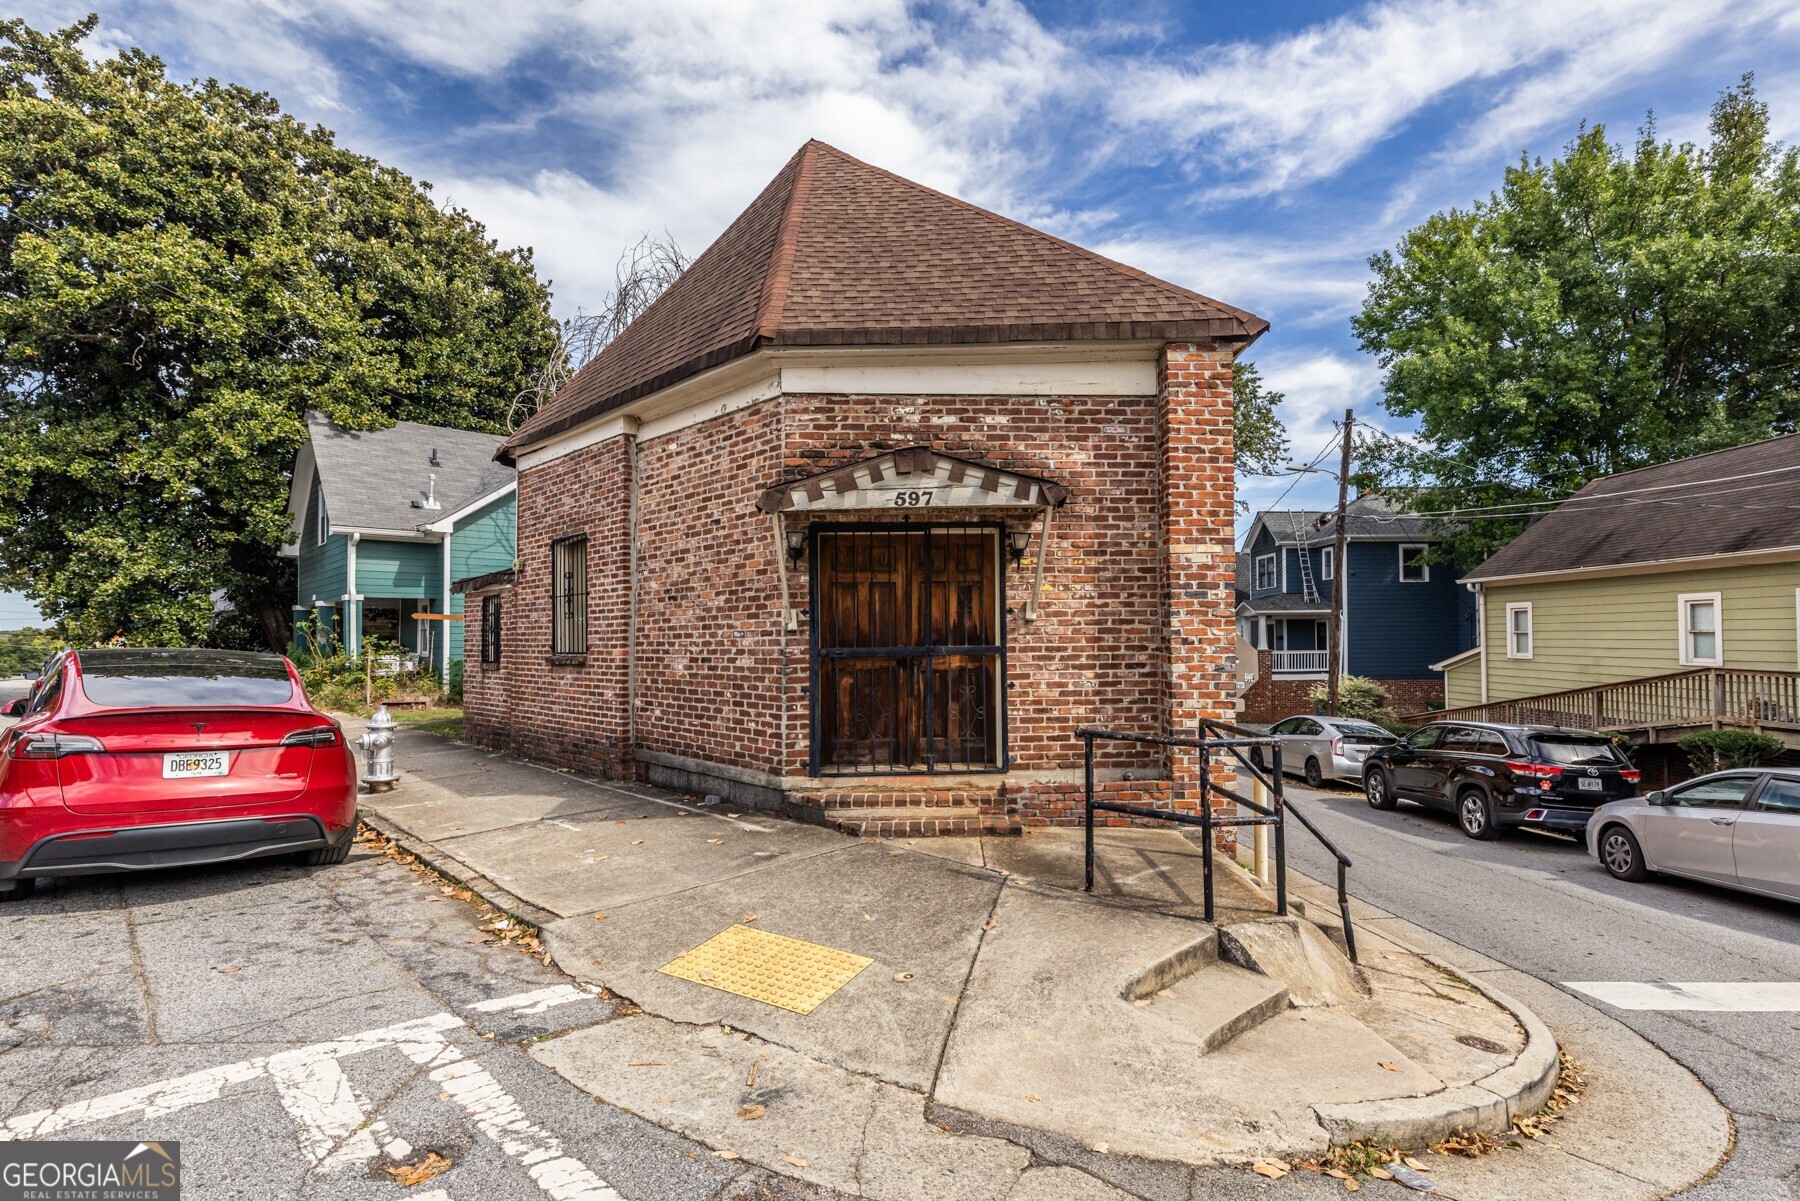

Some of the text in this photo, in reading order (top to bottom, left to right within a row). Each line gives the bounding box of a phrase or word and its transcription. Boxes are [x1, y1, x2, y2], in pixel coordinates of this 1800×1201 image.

[895, 491, 933, 506] 597
[178, 752, 214, 760] GEORGIA
[170, 758, 222, 772] DBE9325
